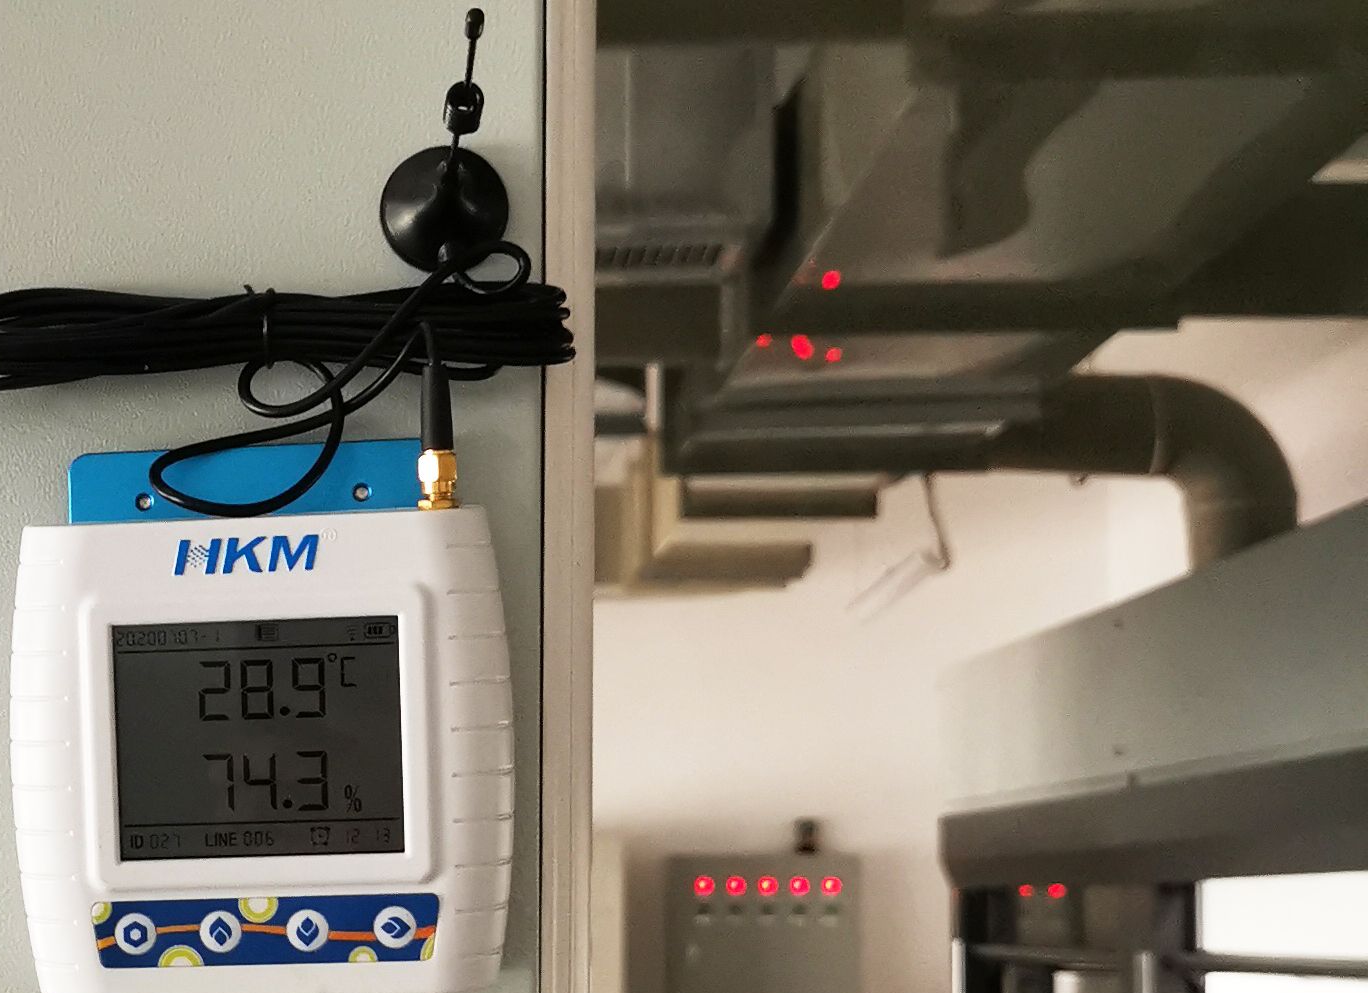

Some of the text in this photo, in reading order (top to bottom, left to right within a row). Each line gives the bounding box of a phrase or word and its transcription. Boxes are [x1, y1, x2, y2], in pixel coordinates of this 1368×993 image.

[173, 533, 320, 576] HKM
[202, 750, 363, 813] 74.3 %
[130, 834, 144, 849] ID
[205, 832, 238, 848] LINE
